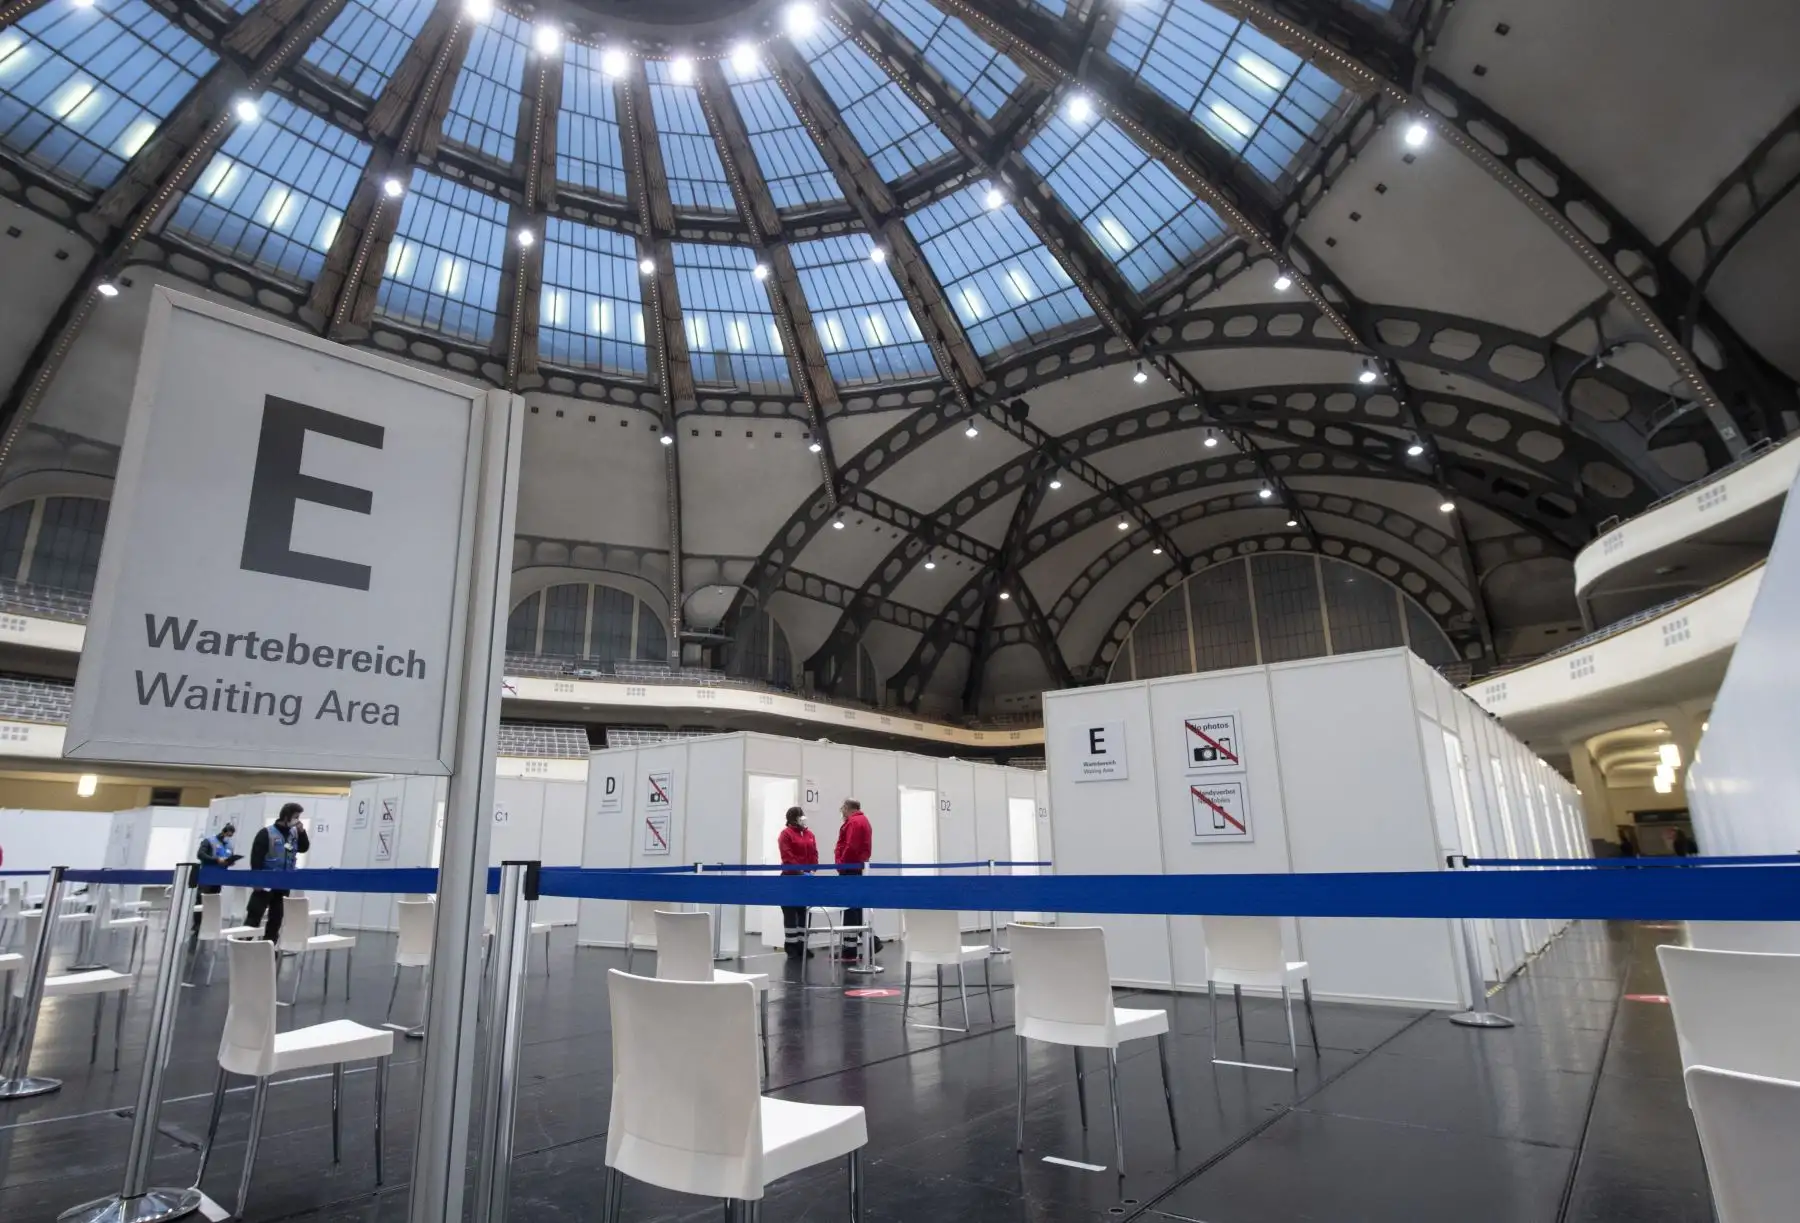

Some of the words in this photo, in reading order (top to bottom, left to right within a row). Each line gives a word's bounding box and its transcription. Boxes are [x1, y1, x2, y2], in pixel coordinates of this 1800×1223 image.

[240, 393, 385, 592] E
[145, 613, 427, 680] Wartebereich
[134, 669, 303, 726] Waiting
[315, 689, 401, 727] Area
[1203, 722, 1229, 732] photos
[1089, 727, 1107, 755] E
[606, 776, 616, 795] D
[806, 789, 819, 804] D1
[358, 800, 366, 815] C
[940, 799, 952, 812] D2
[495, 811, 508, 822] C1
[317, 824, 330, 833] B1
